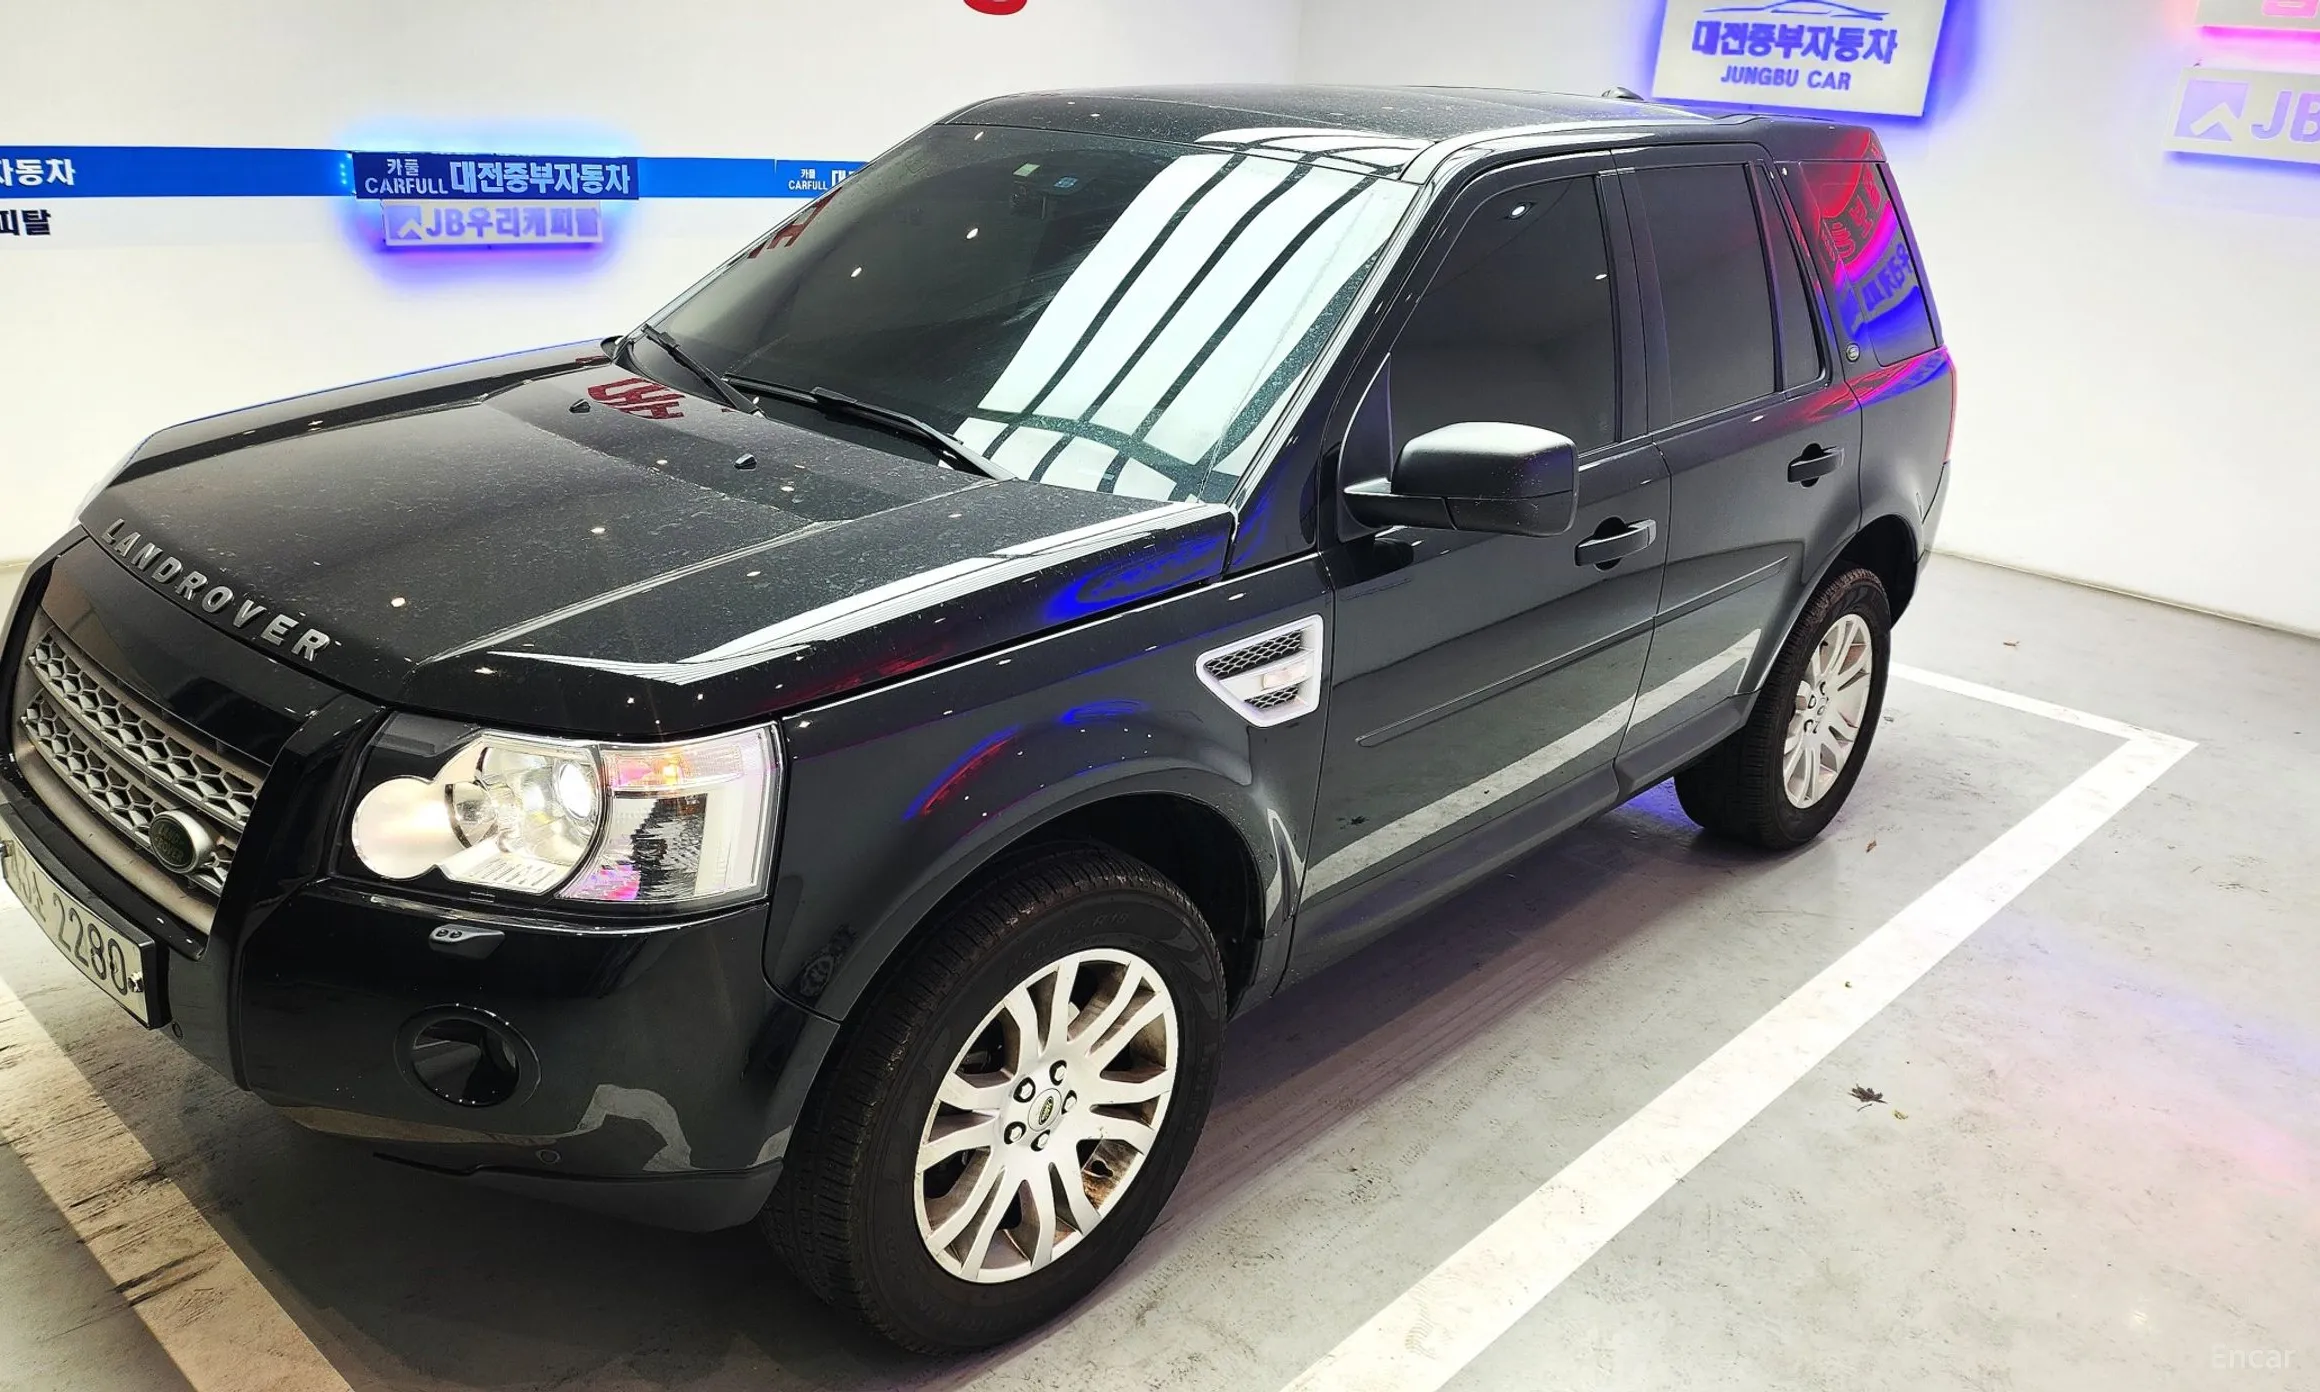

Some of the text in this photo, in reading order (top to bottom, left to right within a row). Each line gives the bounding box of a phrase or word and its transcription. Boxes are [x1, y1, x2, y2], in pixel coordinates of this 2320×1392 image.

[1692, 21, 1898, 64] 대전중부자동차
[1721, 65, 1851, 91] JUNGBU CAR
[364, 177, 449, 195] CARFULL
[450, 160, 631, 194] 대전중부자동차
[788, 180, 828, 190] CARFULL
[53, 892, 128, 996] 2280
